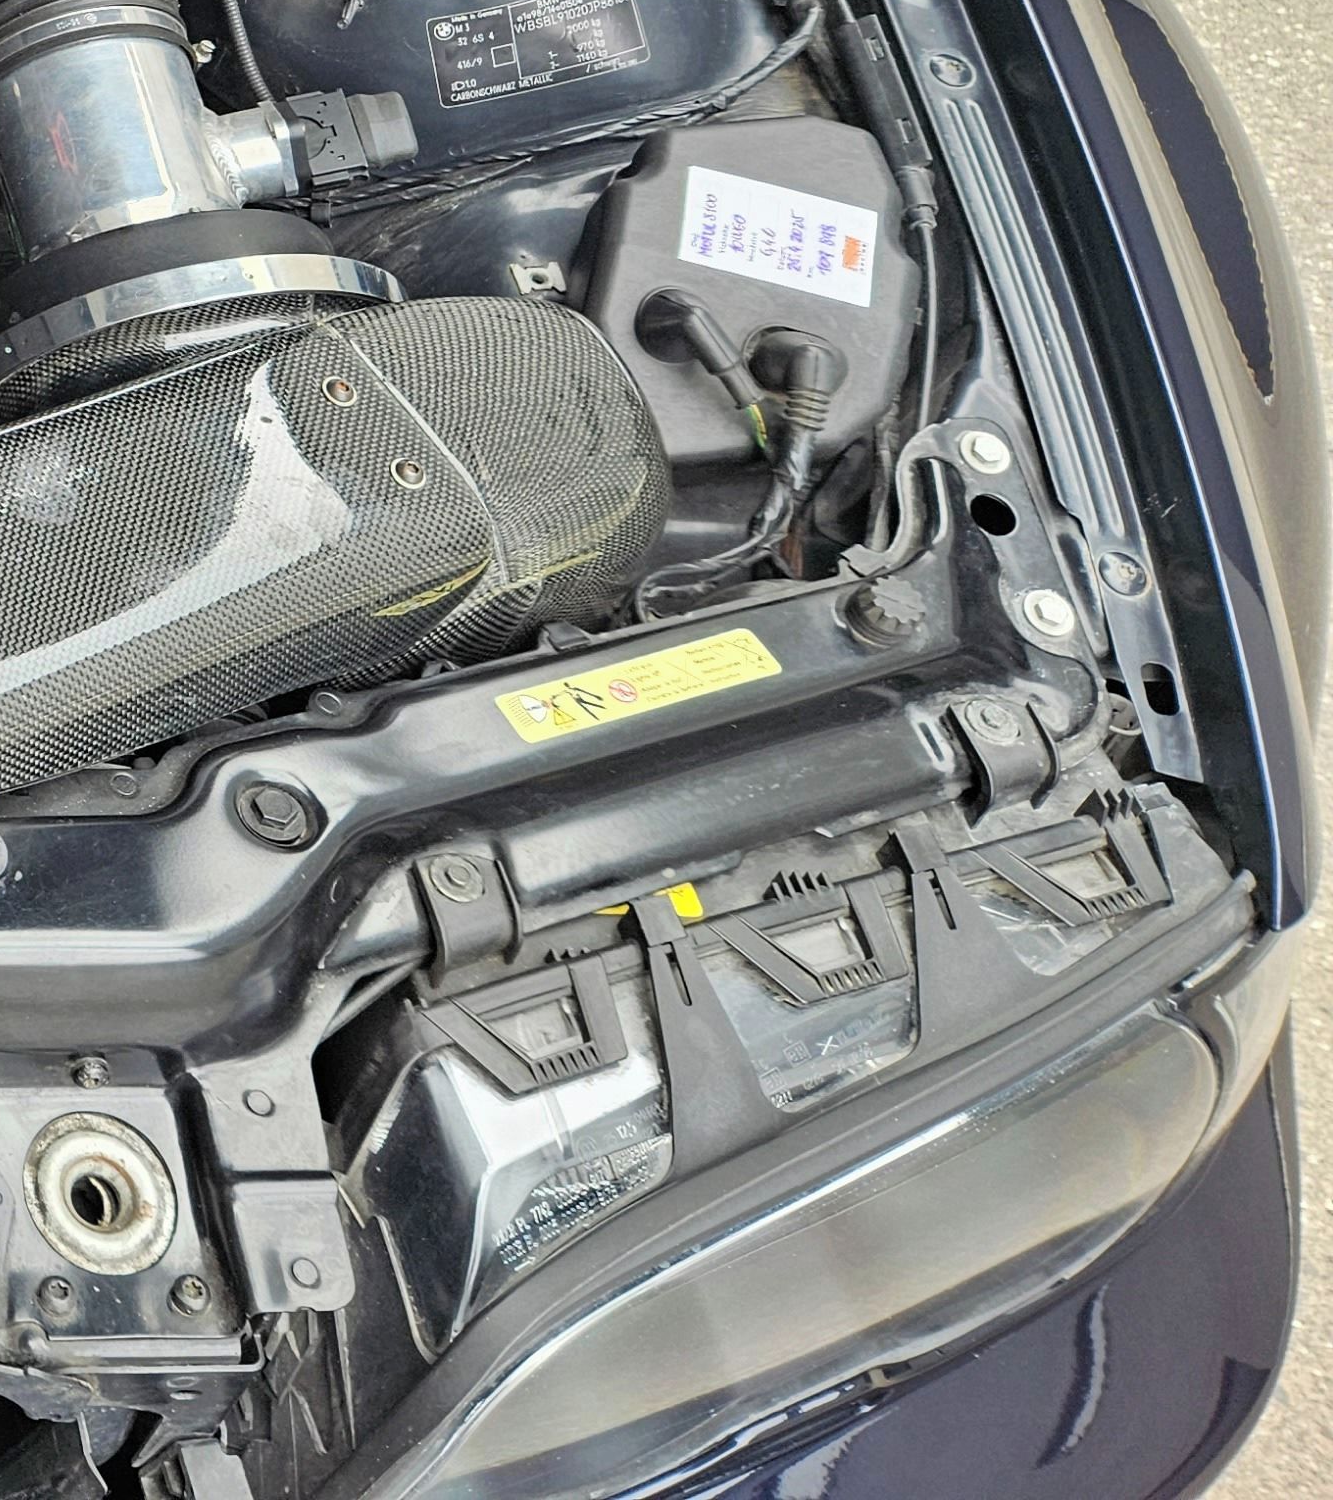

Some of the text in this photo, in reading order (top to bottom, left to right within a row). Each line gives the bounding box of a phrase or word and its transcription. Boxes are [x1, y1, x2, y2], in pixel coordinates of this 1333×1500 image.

[455, 25, 464, 34] M
[457, 36, 468, 46] 32
[488, 32, 495, 41] 4
[457, 57, 483, 70] 416/9
